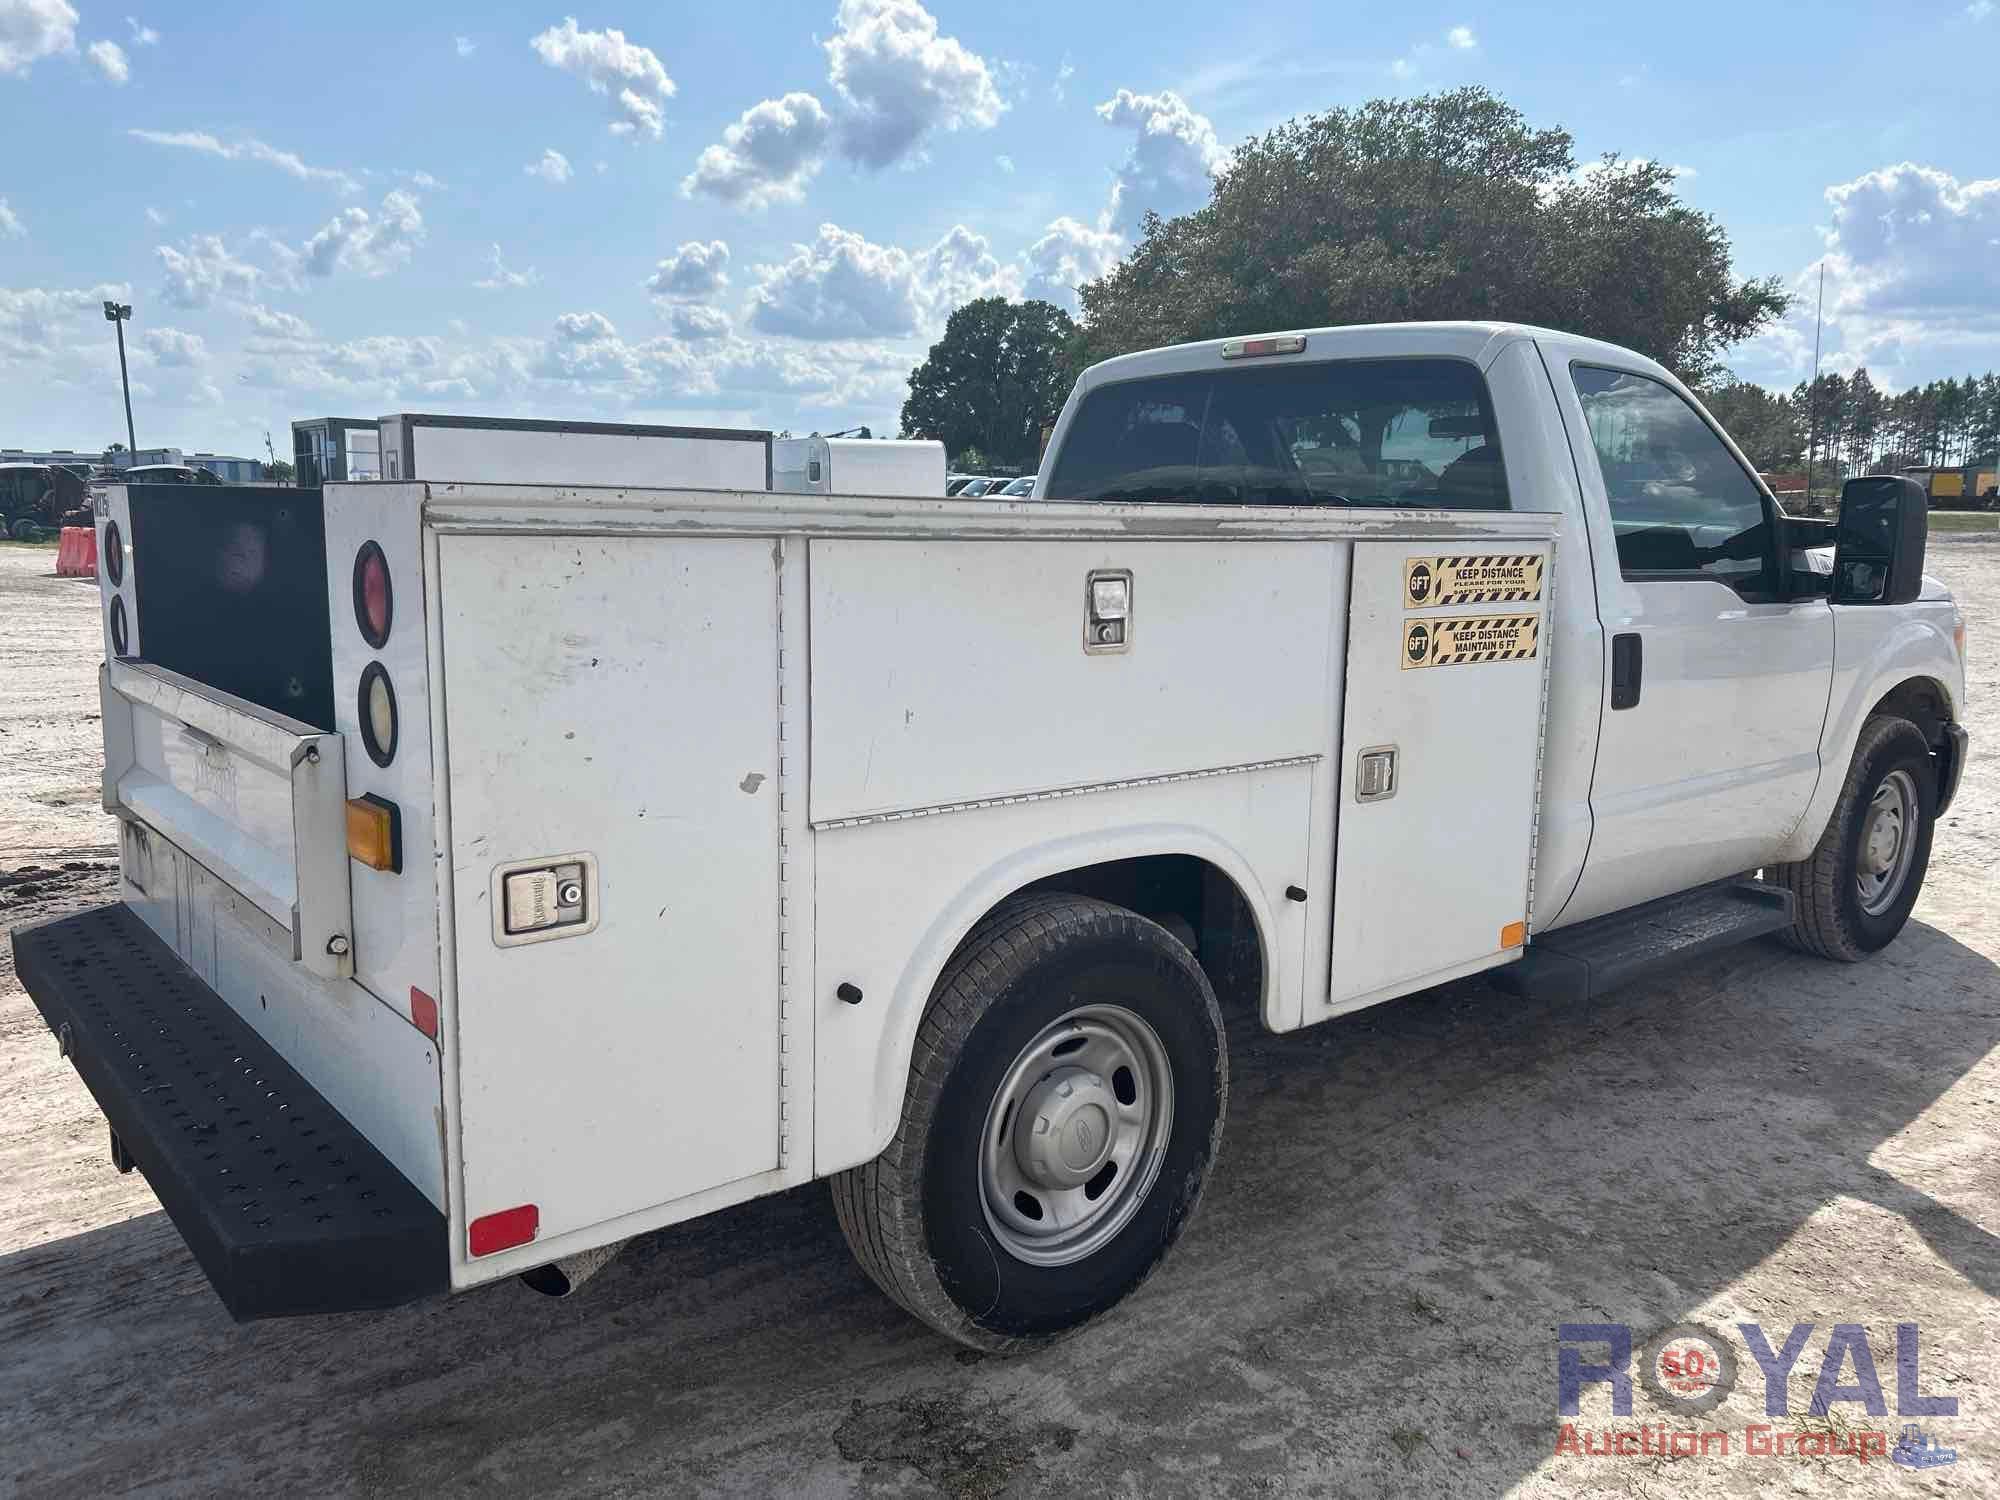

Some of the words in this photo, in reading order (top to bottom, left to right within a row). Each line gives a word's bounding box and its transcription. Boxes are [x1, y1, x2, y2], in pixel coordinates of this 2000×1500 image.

[1456, 568, 1479, 580] KEEP
[1481, 567, 1524, 579] DISTANCE
[1411, 575, 1430, 591] 6FT
[1453, 631, 1476, 641] KEEP
[1478, 628, 1519, 640] DISTANCE
[1409, 636, 1428, 651] 6FT
[1455, 641, 1496, 653] MAINTAIN
[1498, 640, 1504, 650] 6
[1506, 640, 1517, 649] FT
